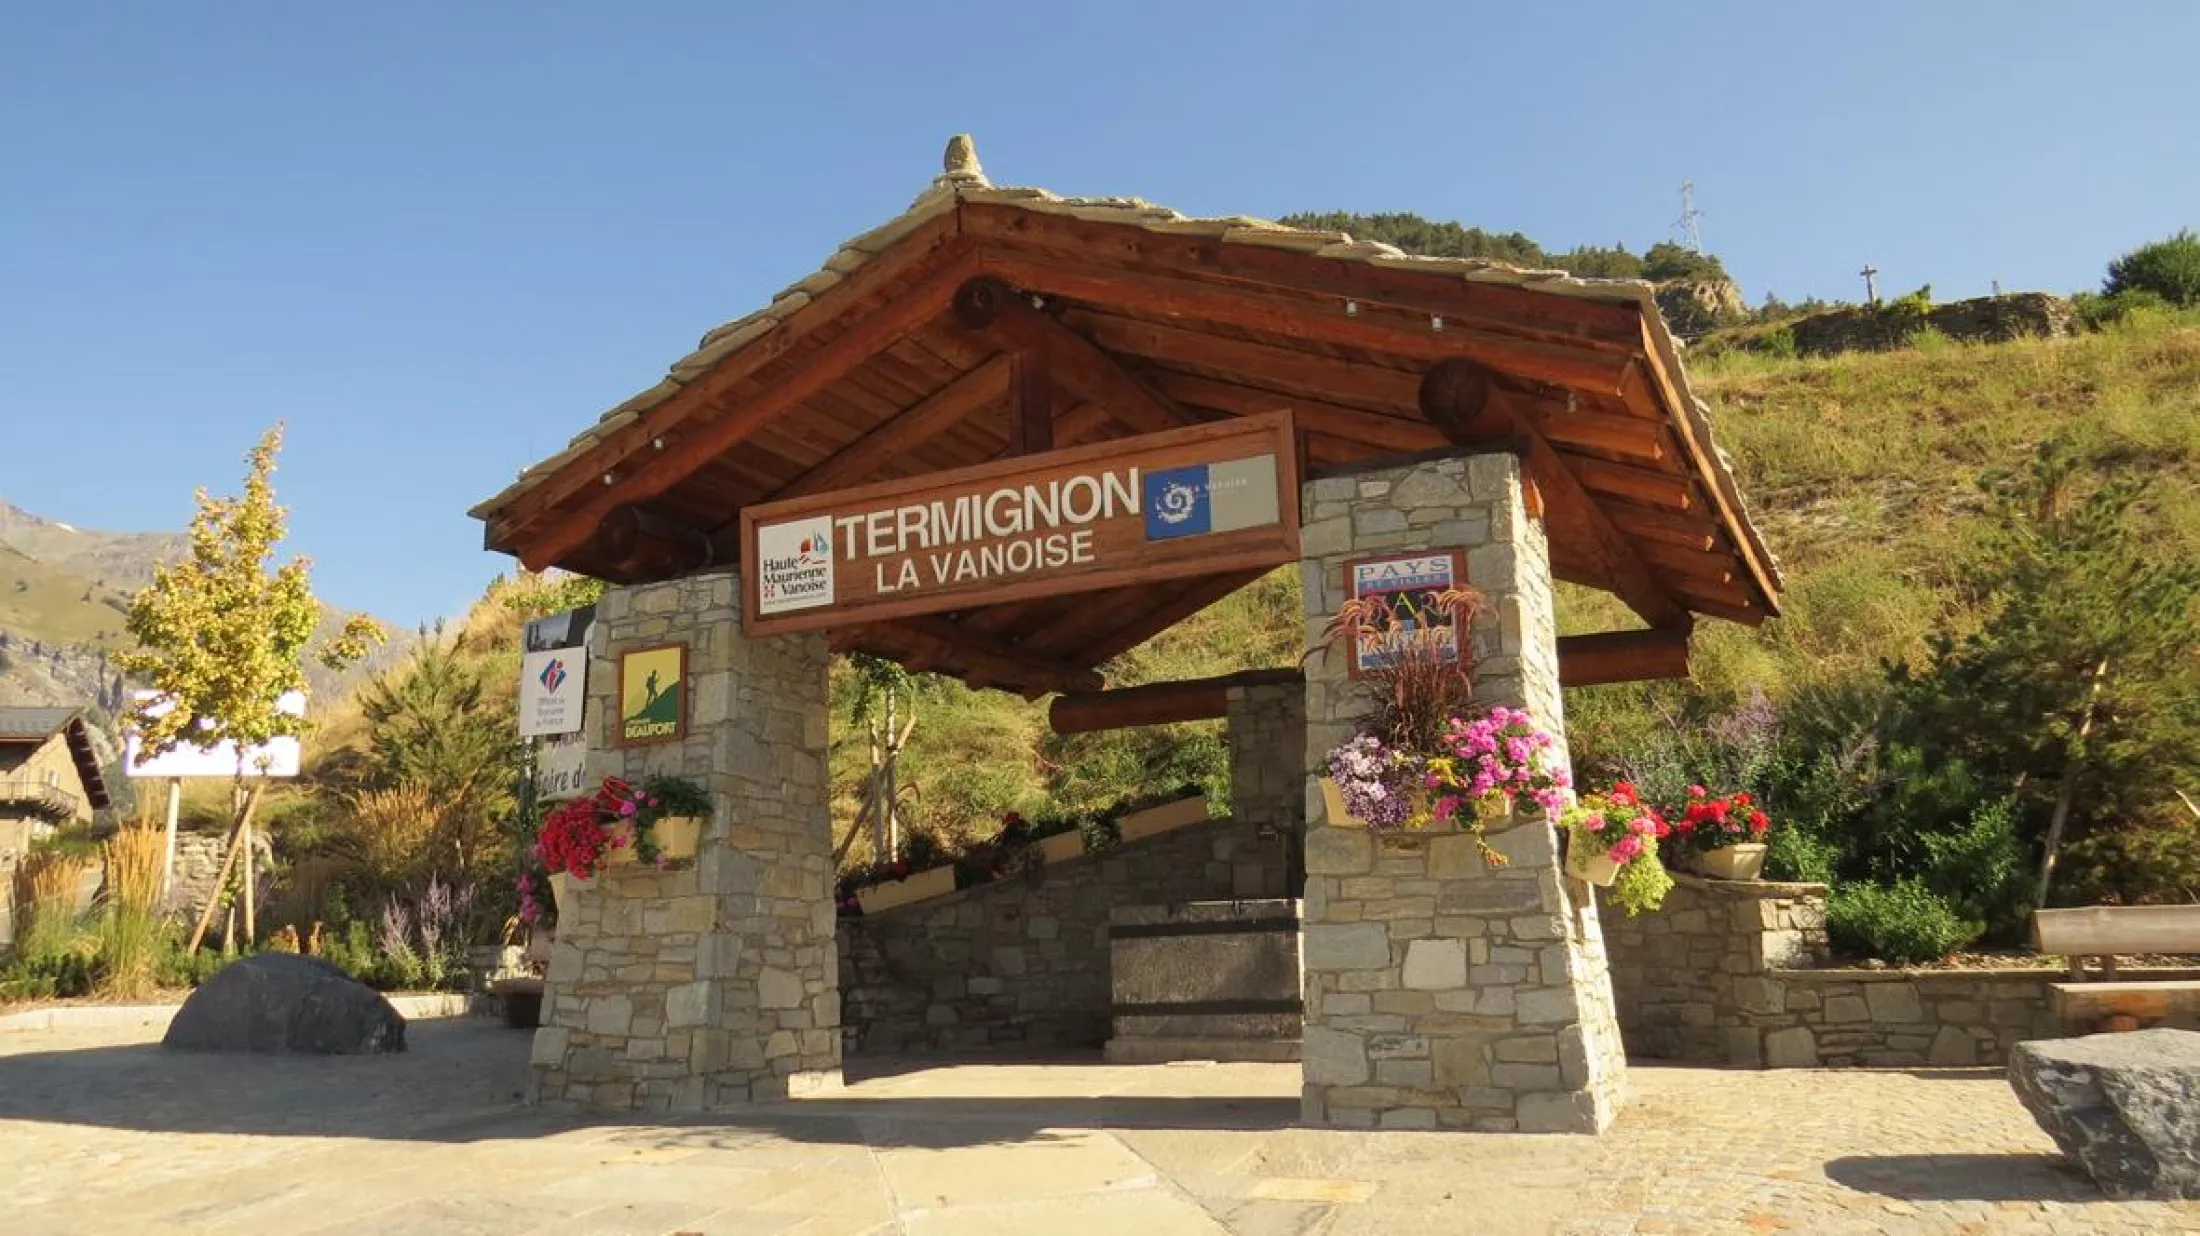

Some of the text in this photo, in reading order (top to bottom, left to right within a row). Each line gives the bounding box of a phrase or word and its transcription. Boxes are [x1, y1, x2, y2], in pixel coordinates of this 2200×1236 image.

[836, 467, 1141, 560] TERMIGNON
[764, 557, 798, 572] Haute
[876, 530, 1095, 593] LA VANOISE
[1359, 557, 1449, 581] PAYS
[764, 567, 828, 584] Maurienne
[781, 580, 828, 596] Vanoise
